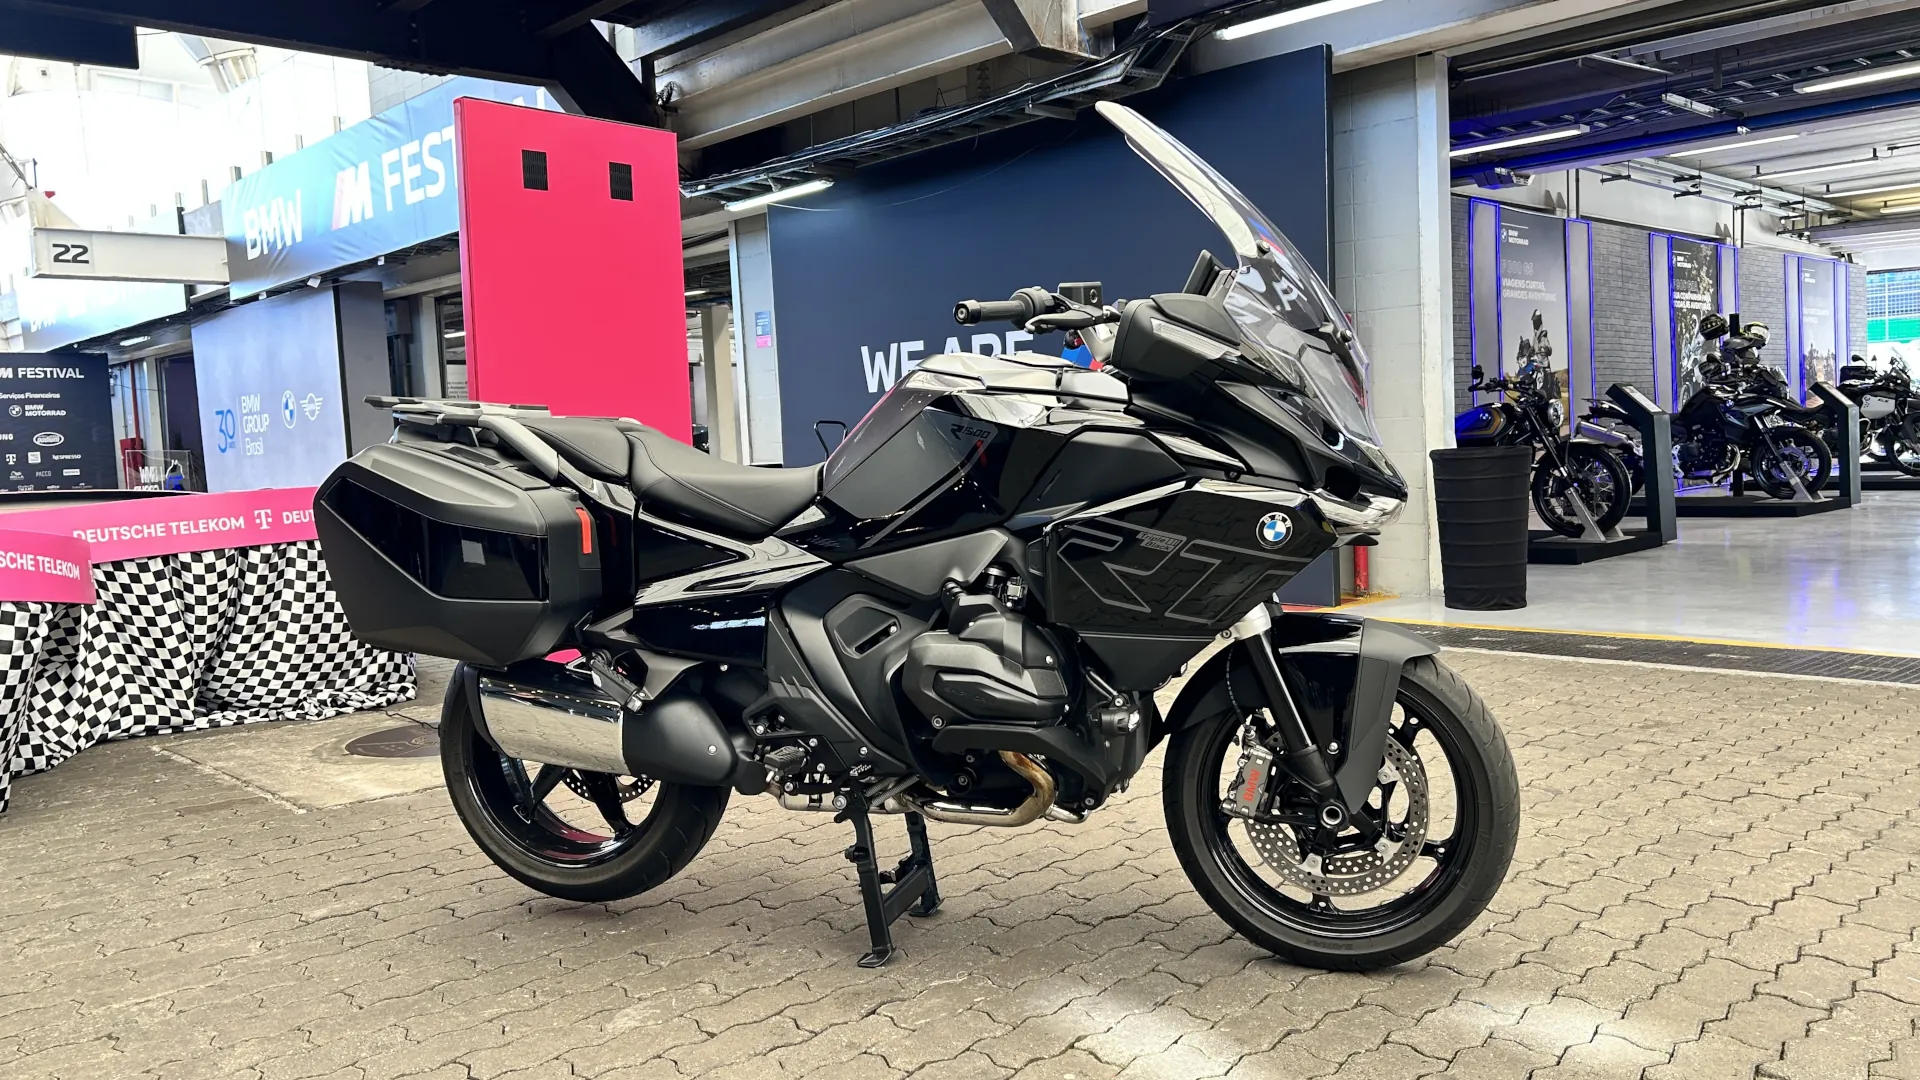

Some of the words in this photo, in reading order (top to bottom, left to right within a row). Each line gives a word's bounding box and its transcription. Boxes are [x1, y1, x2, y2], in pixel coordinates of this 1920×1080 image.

[243, 189, 302, 260] BMW
[52, 243, 90, 264] 22
[18, 367, 84, 379] FESTIVAL
[25, 391, 61, 399] Financeiros
[241, 393, 261, 414] BMW
[215, 409, 236, 454] 30
[243, 413, 270, 434] GROUP
[168, 516, 246, 535] TELEKOM
[36, 555, 80, 580] TELEKOM
[1243, 768, 1261, 802] BMW
